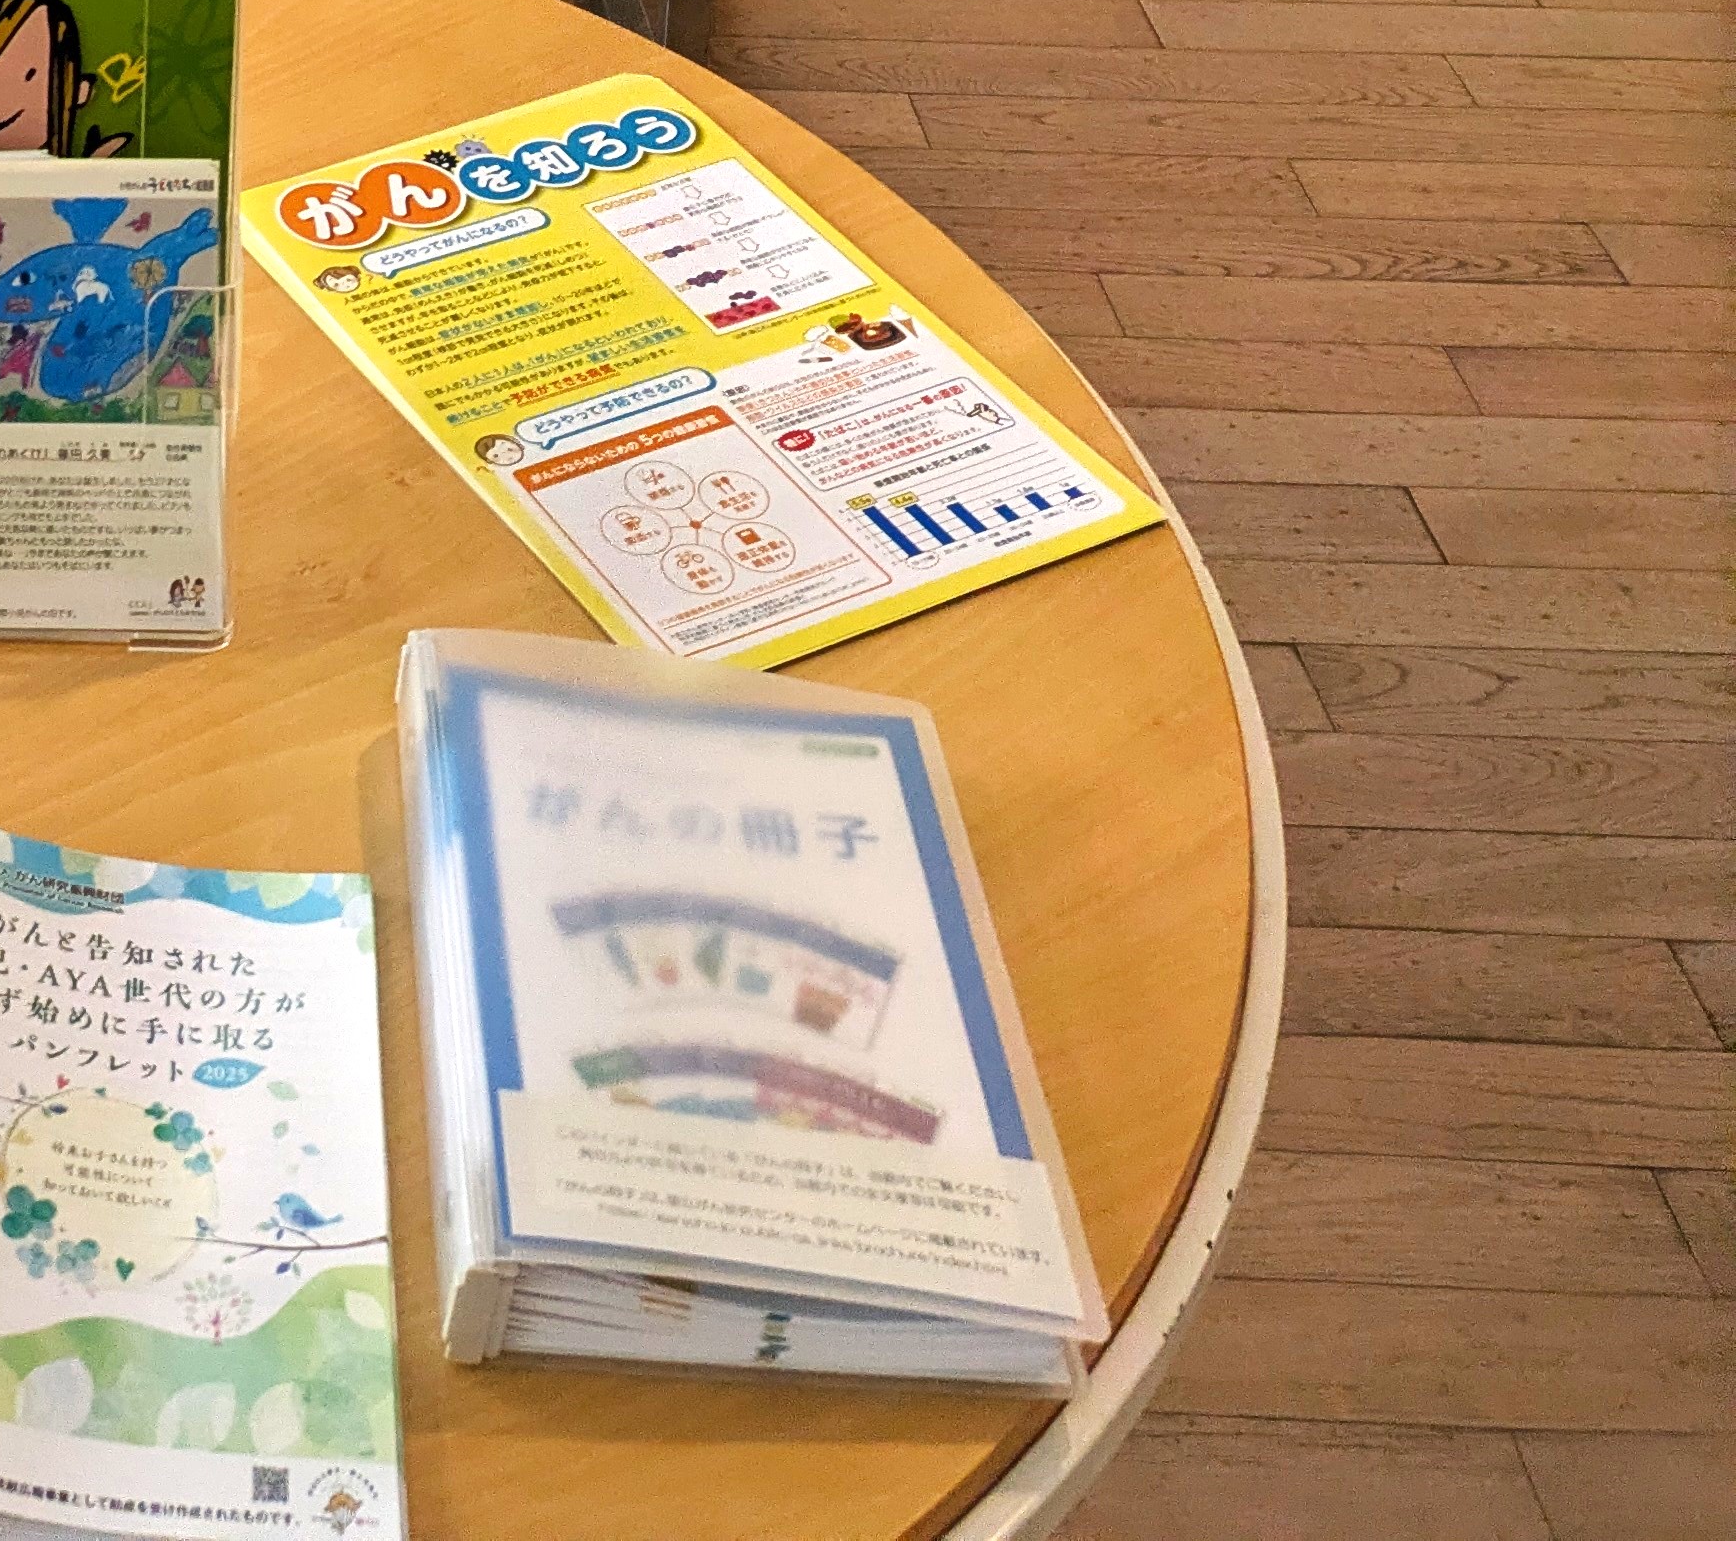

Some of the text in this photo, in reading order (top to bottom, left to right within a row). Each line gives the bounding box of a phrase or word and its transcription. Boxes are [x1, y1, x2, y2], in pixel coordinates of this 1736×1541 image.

[298, 114, 679, 241] がんを知ろう
[379, 215, 529, 266] どうやってがんになるの?
[534, 374, 694, 434] どうやって予防できるの?
[12, 1034, 184, 1084] パンフレット
